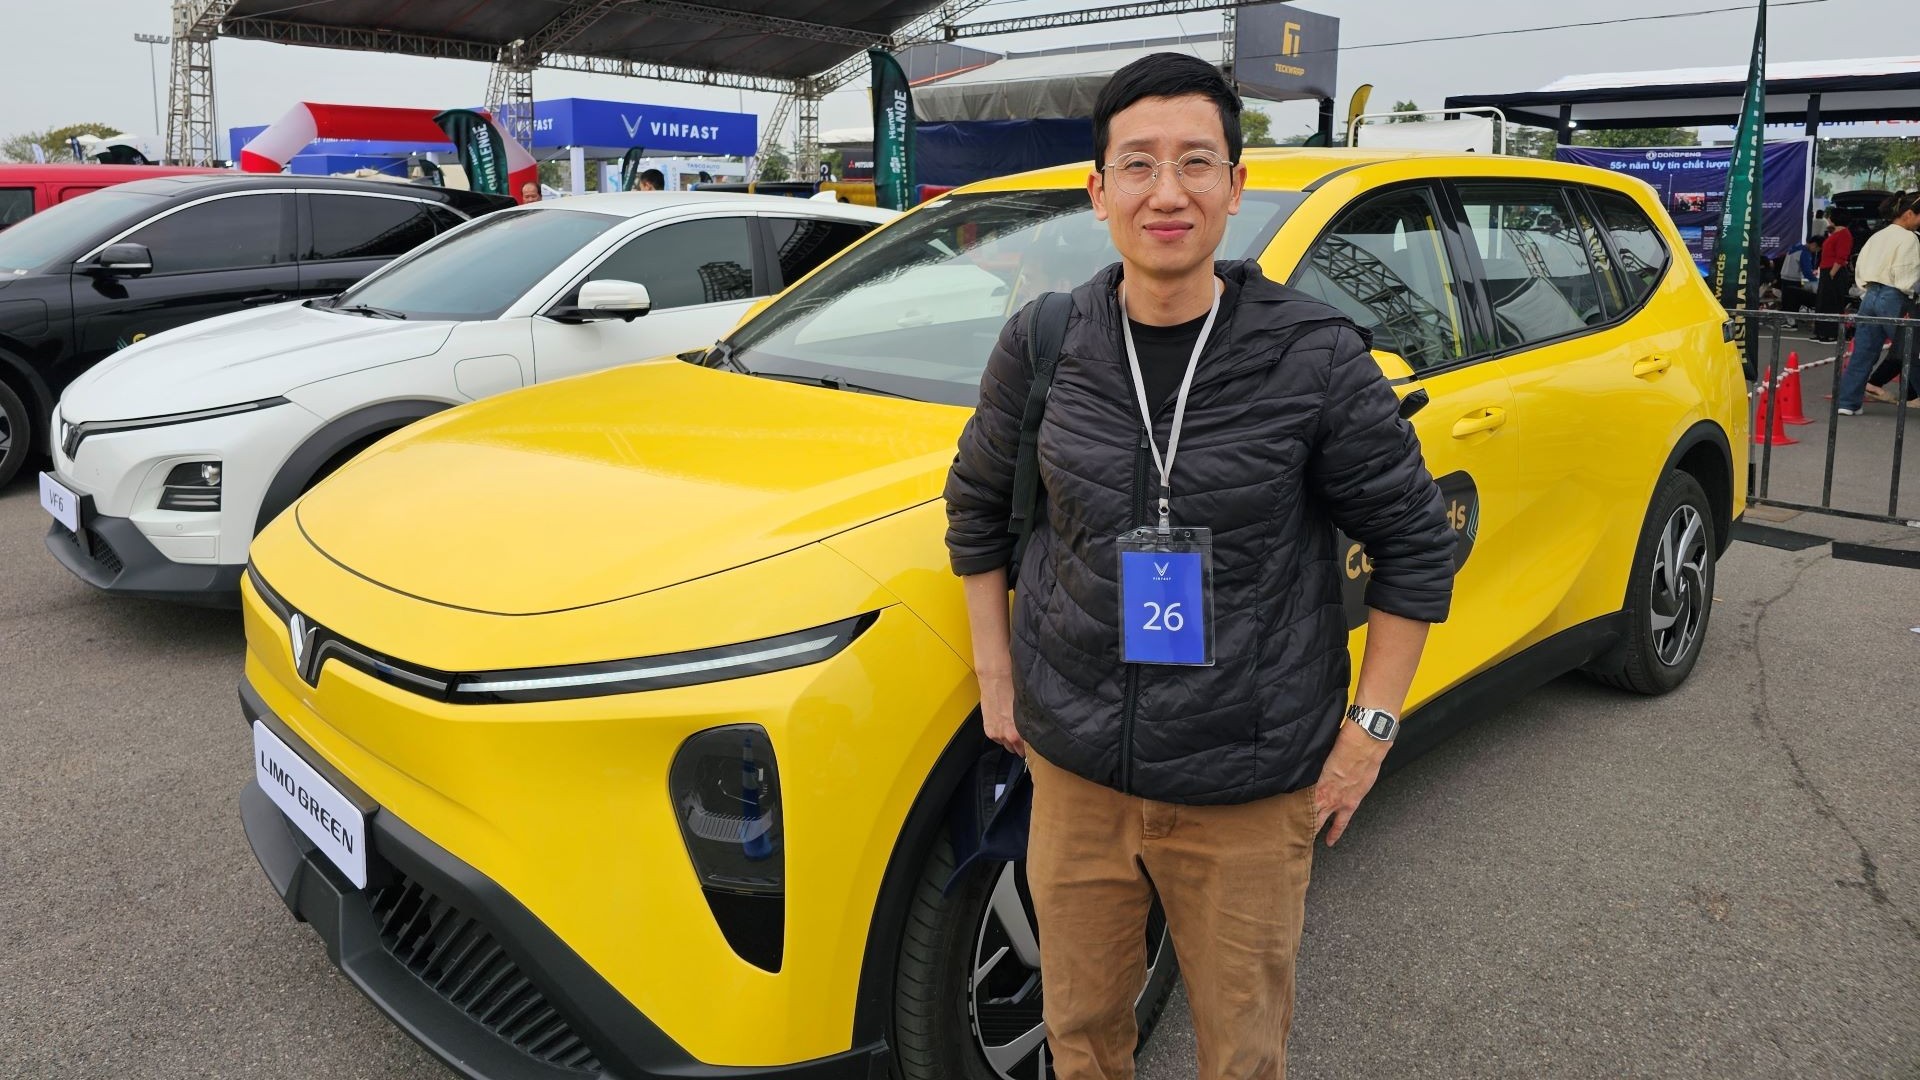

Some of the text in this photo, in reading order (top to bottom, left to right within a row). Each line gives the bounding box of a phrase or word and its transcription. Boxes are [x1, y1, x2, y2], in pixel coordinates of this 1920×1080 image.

[651, 122, 719, 140] VINFAST
[886, 107, 896, 139] Hismart
[1610, 161, 1627, 170] 55+
[1629, 161, 1650, 170] năm
[1652, 161, 1667, 171] Uy
[1706, 159, 1731, 170] lượn
[1713, 253, 1726, 301] wards
[1142, 601, 1184, 632] 26
[261, 750, 354, 855] LIMO GREEN
